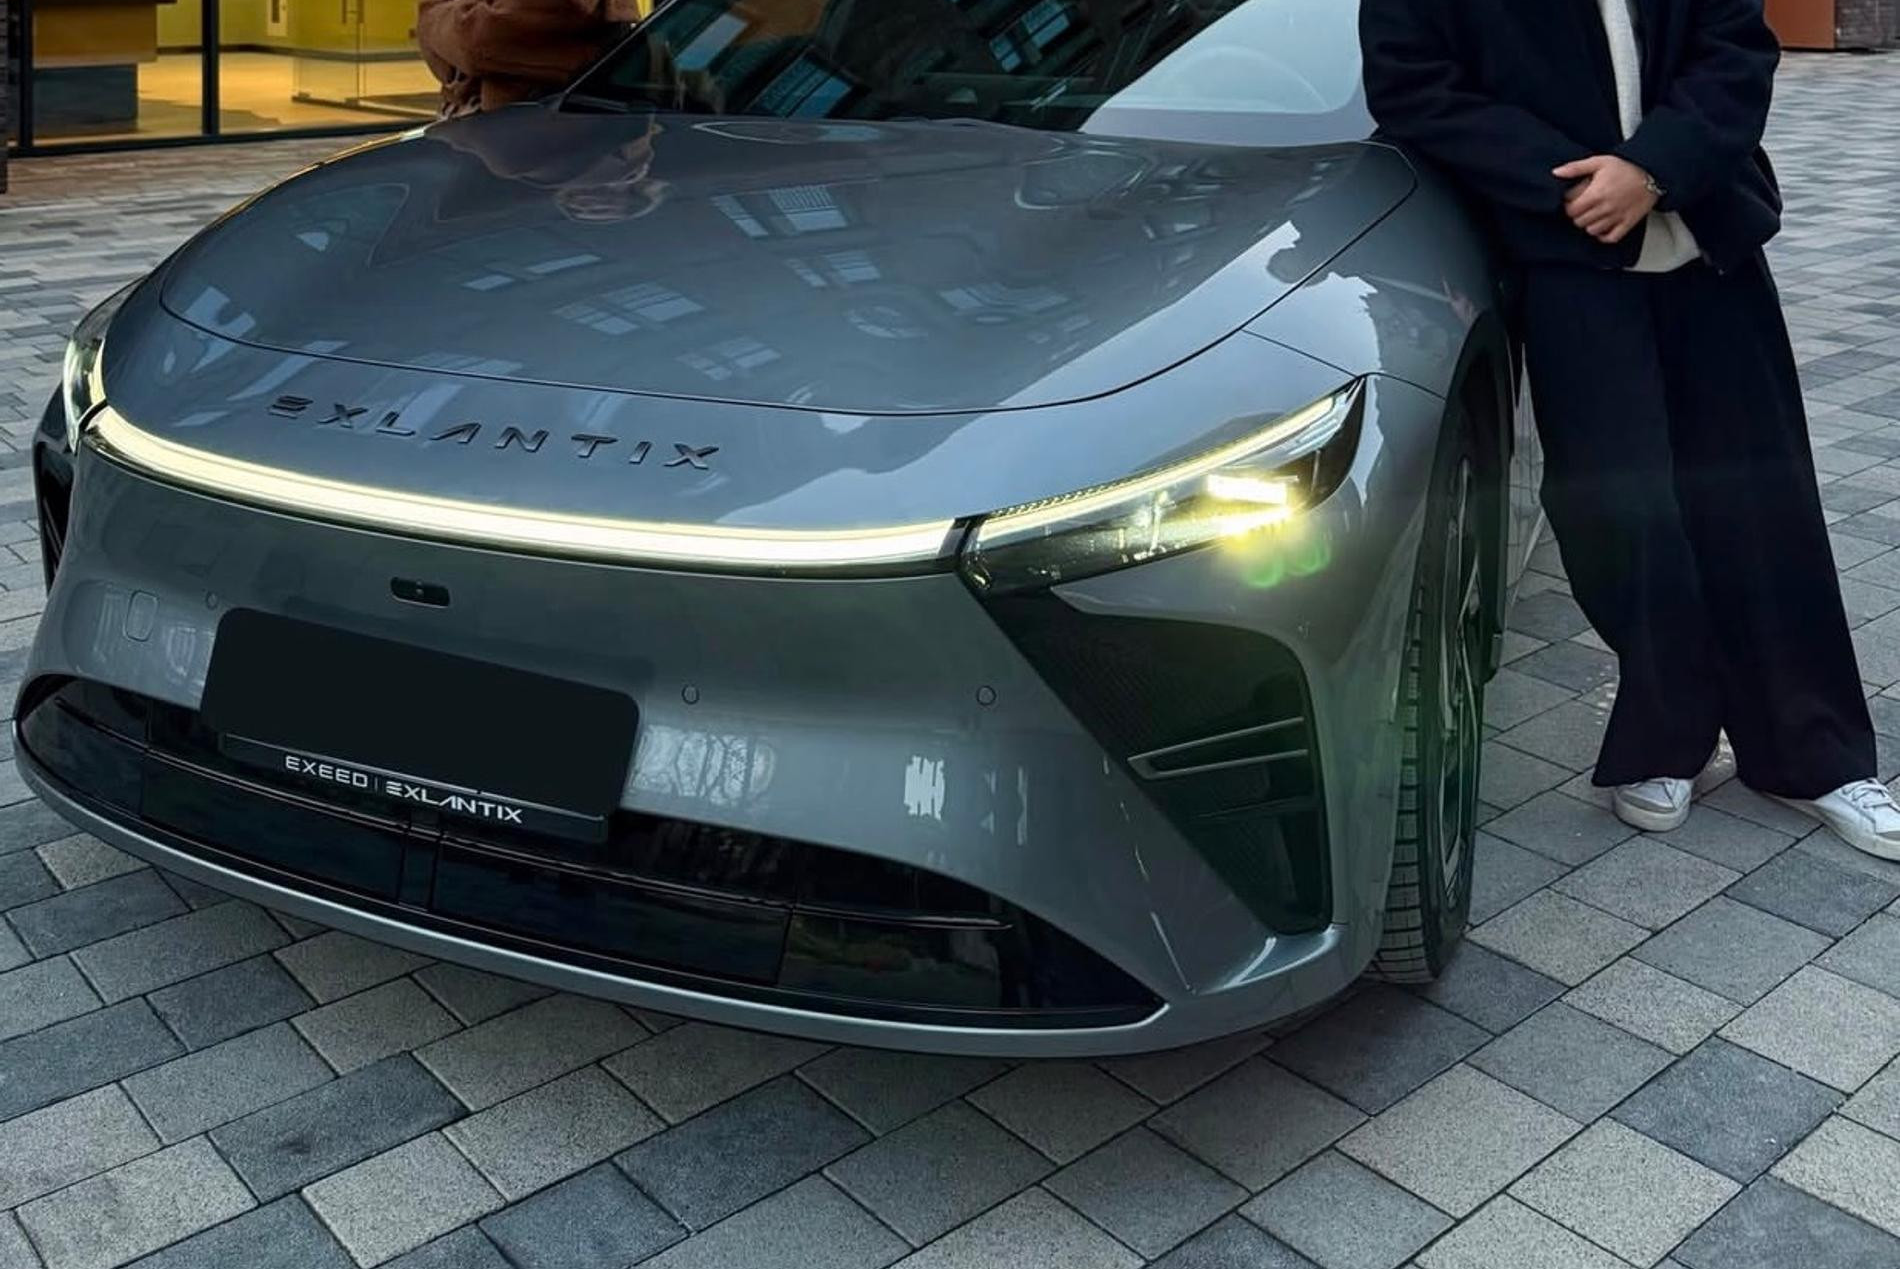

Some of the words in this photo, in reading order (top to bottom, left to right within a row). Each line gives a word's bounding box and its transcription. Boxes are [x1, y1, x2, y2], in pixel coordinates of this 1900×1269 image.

[269, 396, 720, 469] EXLANTIX
[285, 755, 368, 788] EXEED
[385, 780, 523, 824] EXLANTIX
